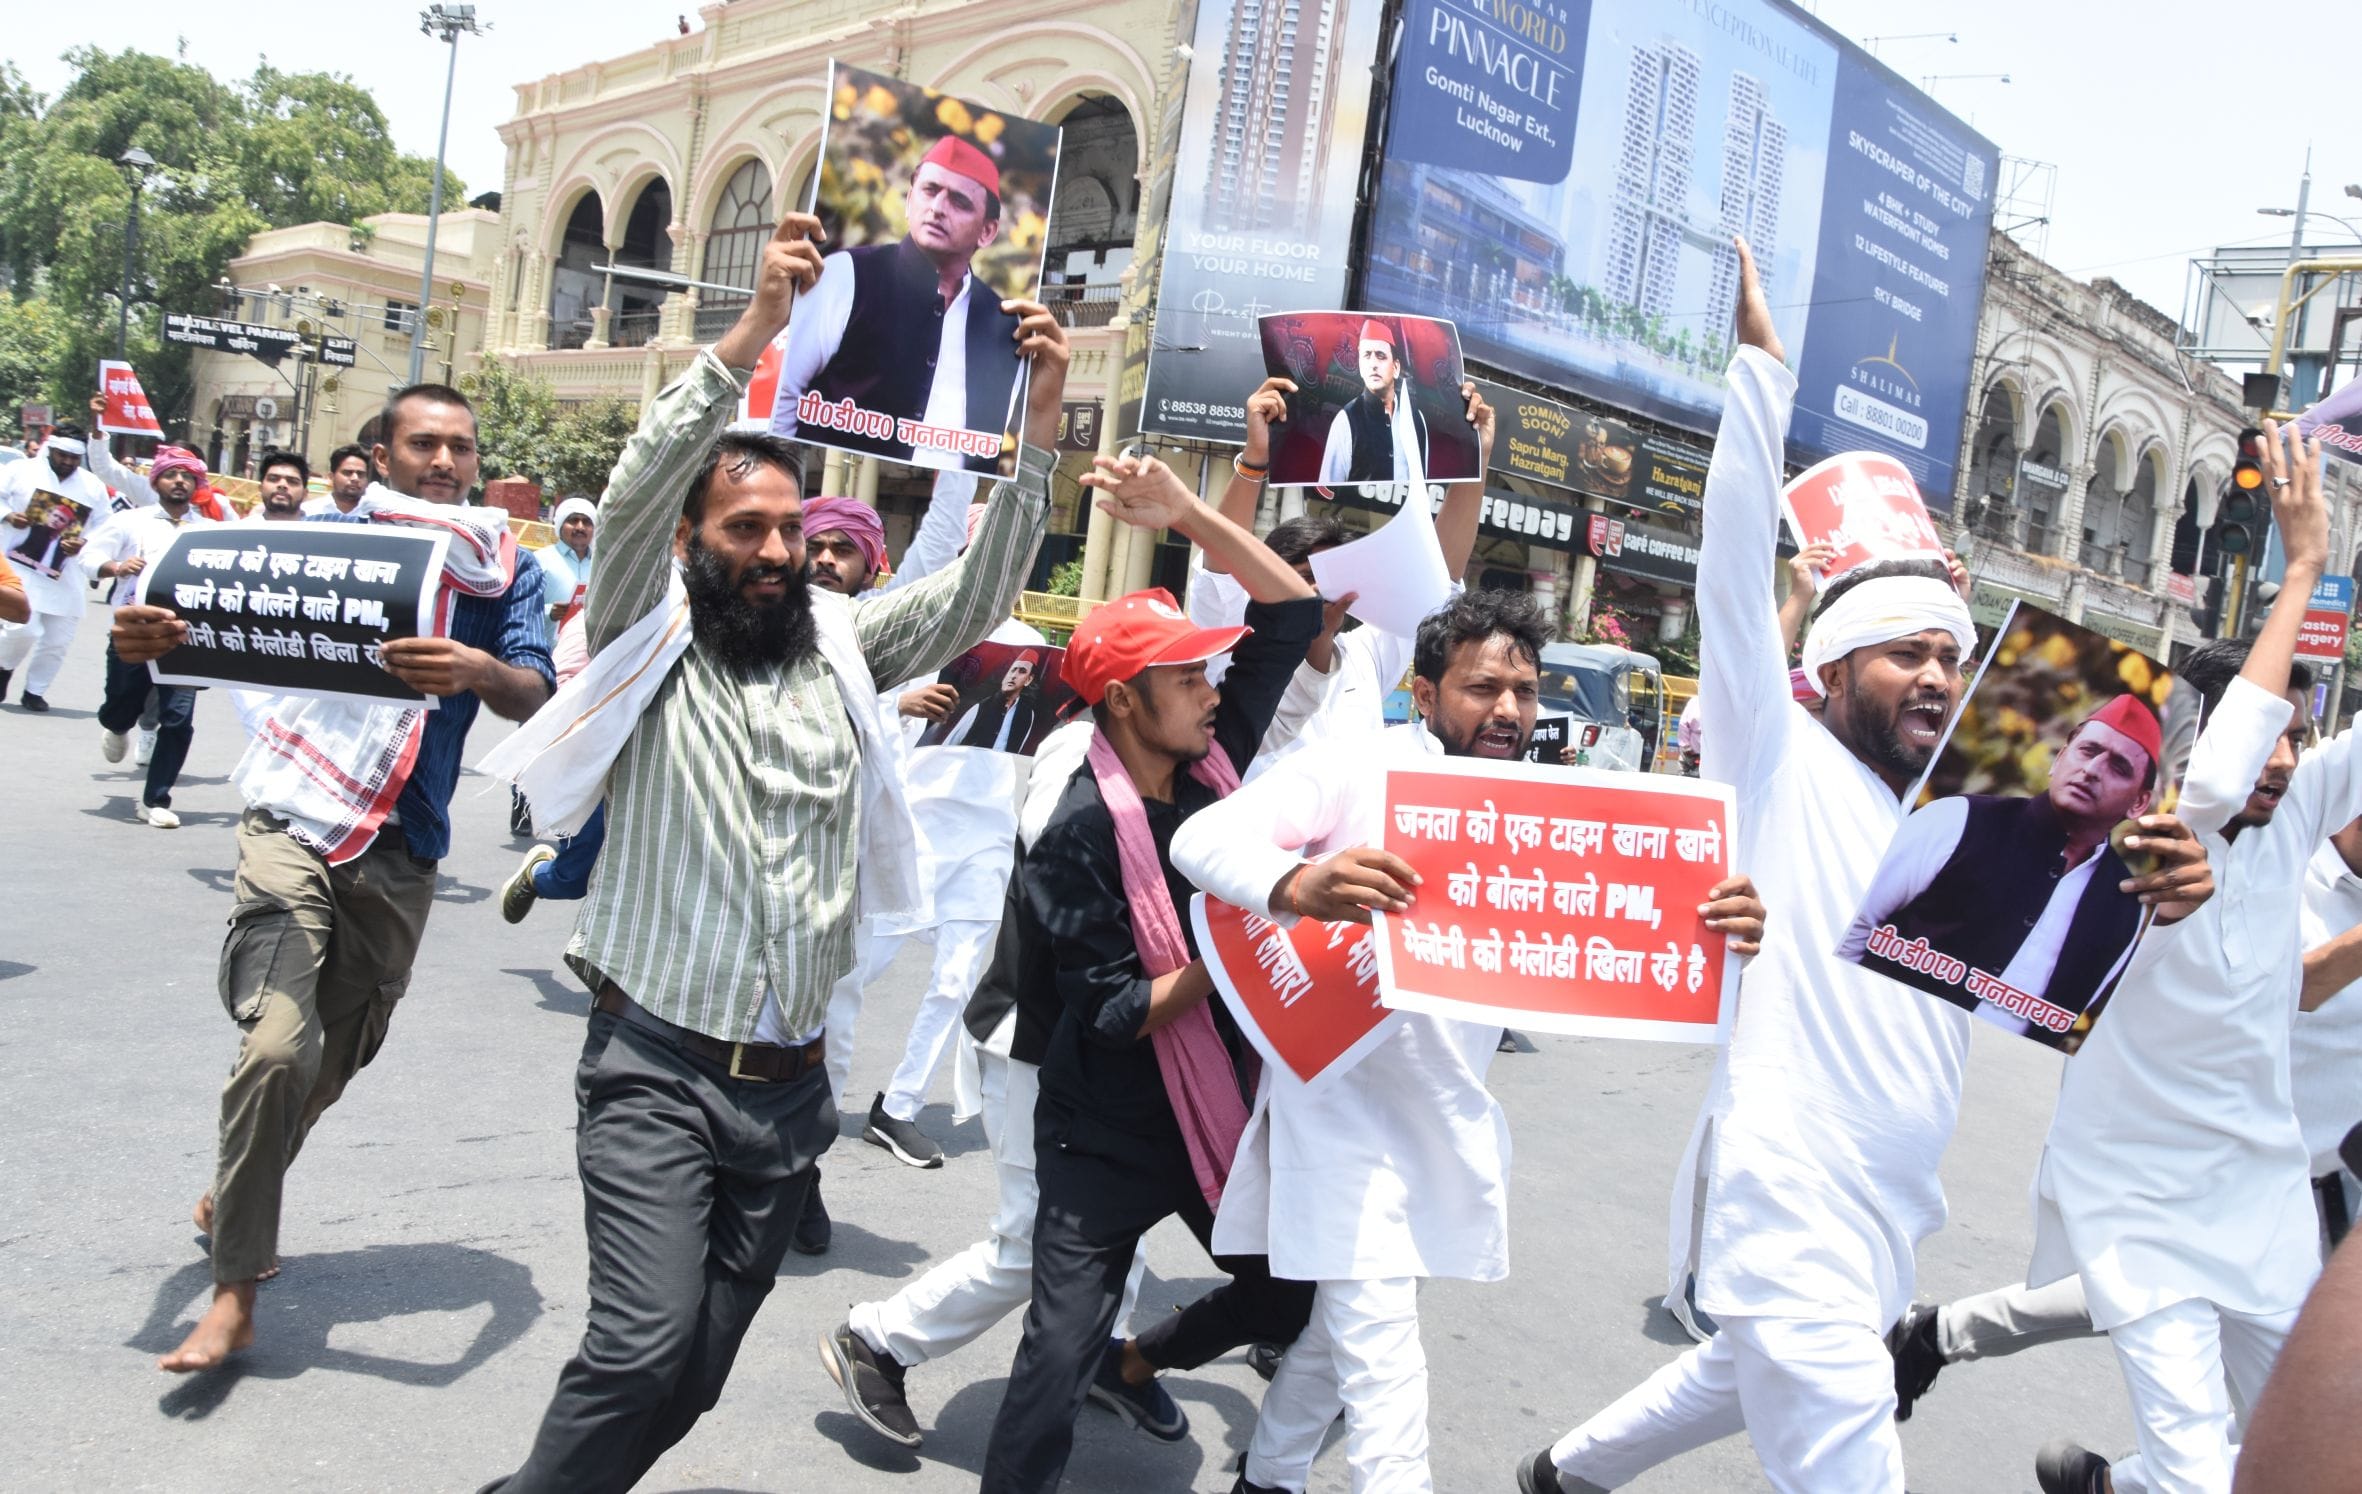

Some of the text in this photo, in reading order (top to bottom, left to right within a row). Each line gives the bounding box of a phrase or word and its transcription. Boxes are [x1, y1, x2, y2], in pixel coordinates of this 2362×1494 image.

[1429, 6, 1566, 112] PINNACLE
[1426, 66, 1556, 149] Gomti Nagar Ext.,
[1456, 106, 1523, 153] Lucknow
[1849, 130, 1974, 220] SKYSCRAPER OF THE CITY
[1864, 199, 1949, 260] WATERFRONT HOMES
[1878, 192, 1885, 205] 4
[1885, 194, 1904, 215] BHK
[1913, 212, 1940, 237] STUDY
[1190, 232, 1320, 260] YOUR FLOOR
[1855, 234, 1949, 296] 12 LIFESTYLE FEATURES
[1192, 254, 1316, 282] YOUR HOME
[1874, 286, 1922, 322] SKY BRIDGE
[246, 325, 301, 342] PARKING
[1851, 366, 1921, 407] SHALIMAR
[1171, 401, 1245, 419] 88538 88538
[1518, 404, 1571, 430] COMING
[1522, 418, 1565, 440] SOON!
[1840, 395, 1858, 415] Call
[1866, 405, 1893, 430] 88801
[1896, 417, 1922, 441] 00200
[897, 415, 1003, 458] जननायक
[1509, 437, 1569, 468] Sapru Marg,
[1510, 453, 1566, 481] Hazratganj
[1652, 466, 1702, 497] Hazratganj
[187, 545, 401, 585] जनता को एक टाइम खाना
[174, 579, 391, 633] खाने को बोलने वाले PM,
[2302, 621, 2340, 632] astro
[219, 624, 247, 652] को
[249, 632, 309, 659] मेलोडी
[310, 632, 359, 664] खिला
[2297, 633, 2342, 648] urgery
[1394, 800, 1721, 864] जनता को एक टाइम खाना खाने
[1448, 862, 1662, 930] को बोलने वाले PM,
[1401, 920, 1466, 970] मेलोनी
[1472, 928, 1504, 973] को
[1509, 930, 1579, 979] मेलोडी
[1585, 935, 1645, 984] खिला
[1651, 941, 1682, 992] रहे
[1687, 943, 1707, 994] है
[1965, 967, 2079, 1034] जननायक
